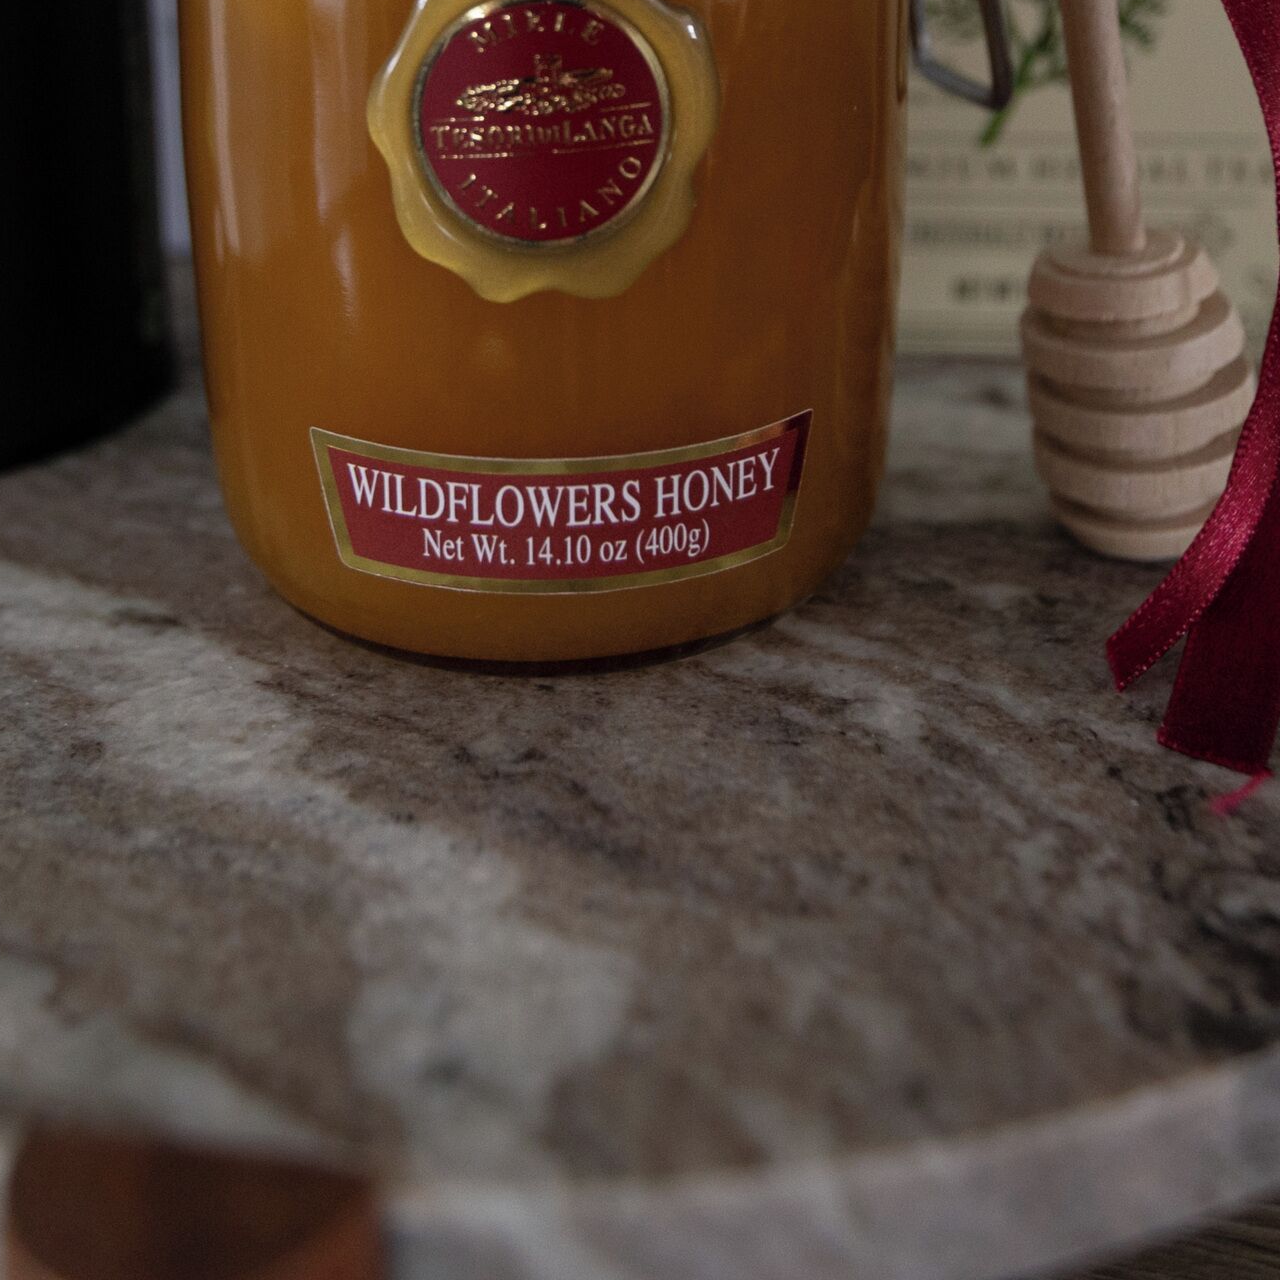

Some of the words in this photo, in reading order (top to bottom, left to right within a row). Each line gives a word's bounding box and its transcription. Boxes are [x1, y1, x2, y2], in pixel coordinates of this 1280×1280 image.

[458, 155, 643, 230] ITALIANO
[345, 462, 643, 529] WILDFLOWERS
[652, 446, 782, 519] HONEY
[421, 528, 465, 563] Net
[469, 533, 516, 566] Wt.
[525, 535, 593, 567] 14.10
[598, 538, 629, 562] oz
[634, 519, 711, 564] (400g)
